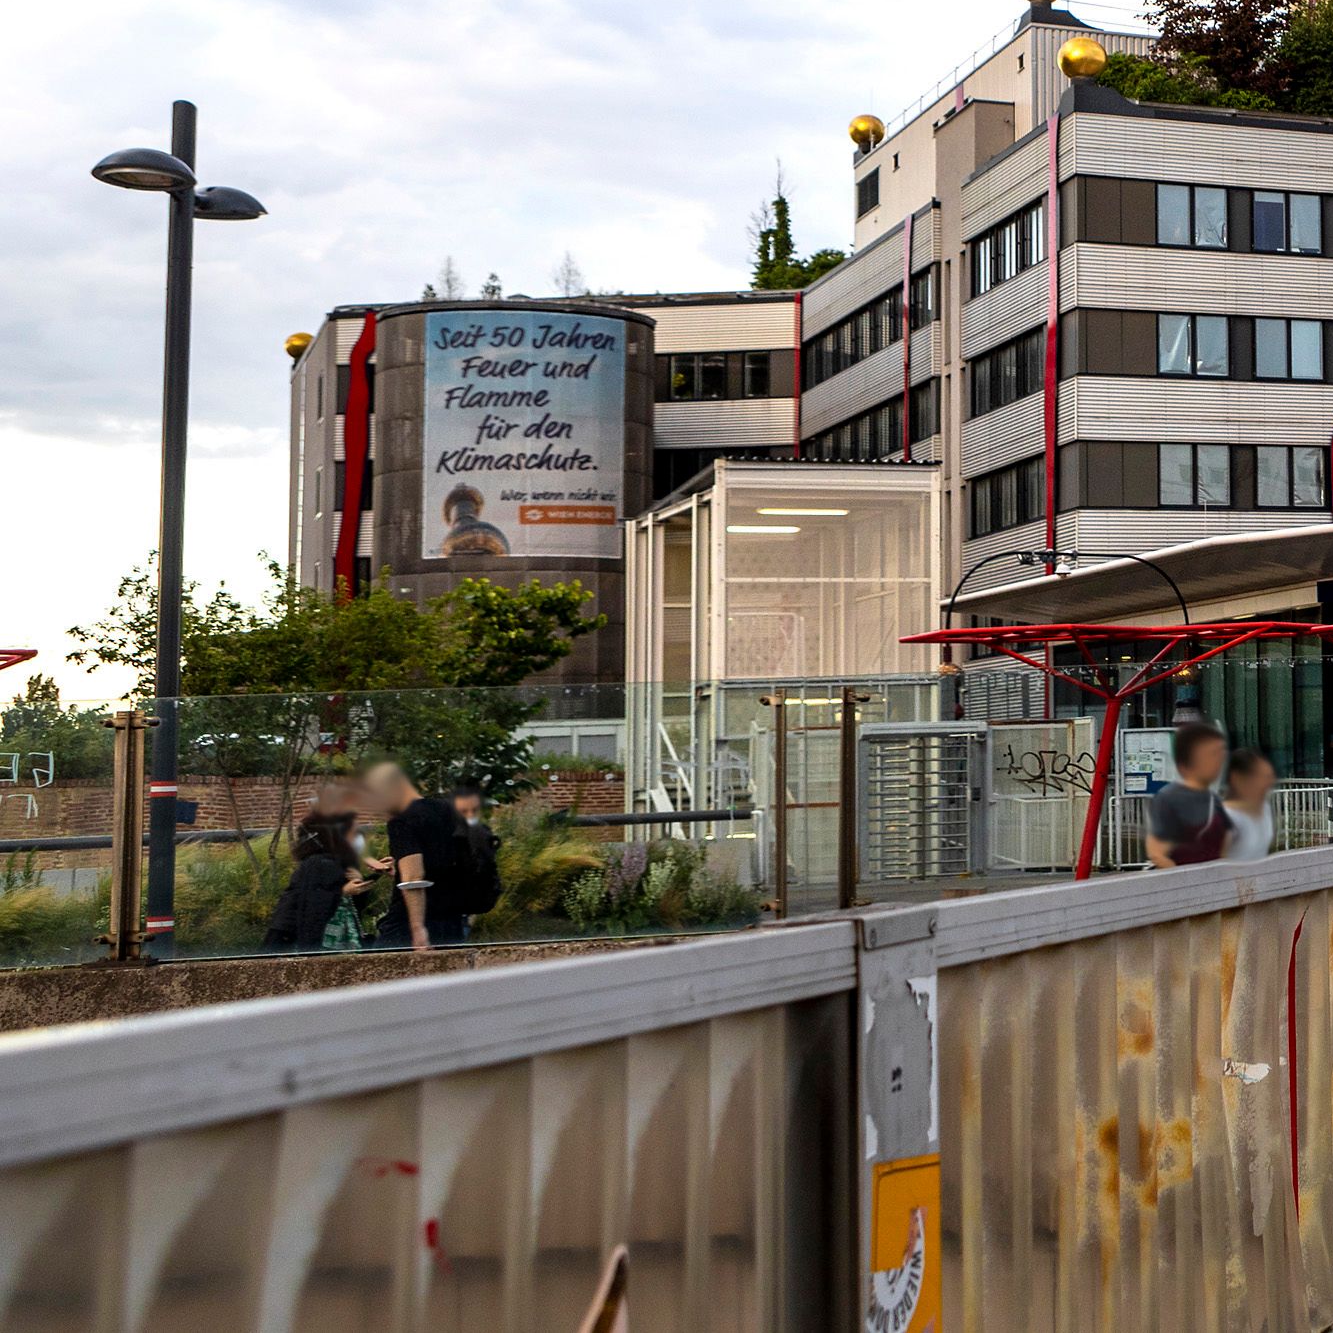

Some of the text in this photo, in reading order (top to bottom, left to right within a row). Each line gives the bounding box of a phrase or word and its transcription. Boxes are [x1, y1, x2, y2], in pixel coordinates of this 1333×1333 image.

[434, 323, 616, 351] Seit 50 Jahren
[461, 354, 597, 379] Feuer und
[445, 385, 551, 409] Flamme
[476, 413, 573, 444] für den
[436, 444, 599, 474] Klimaschutz.
